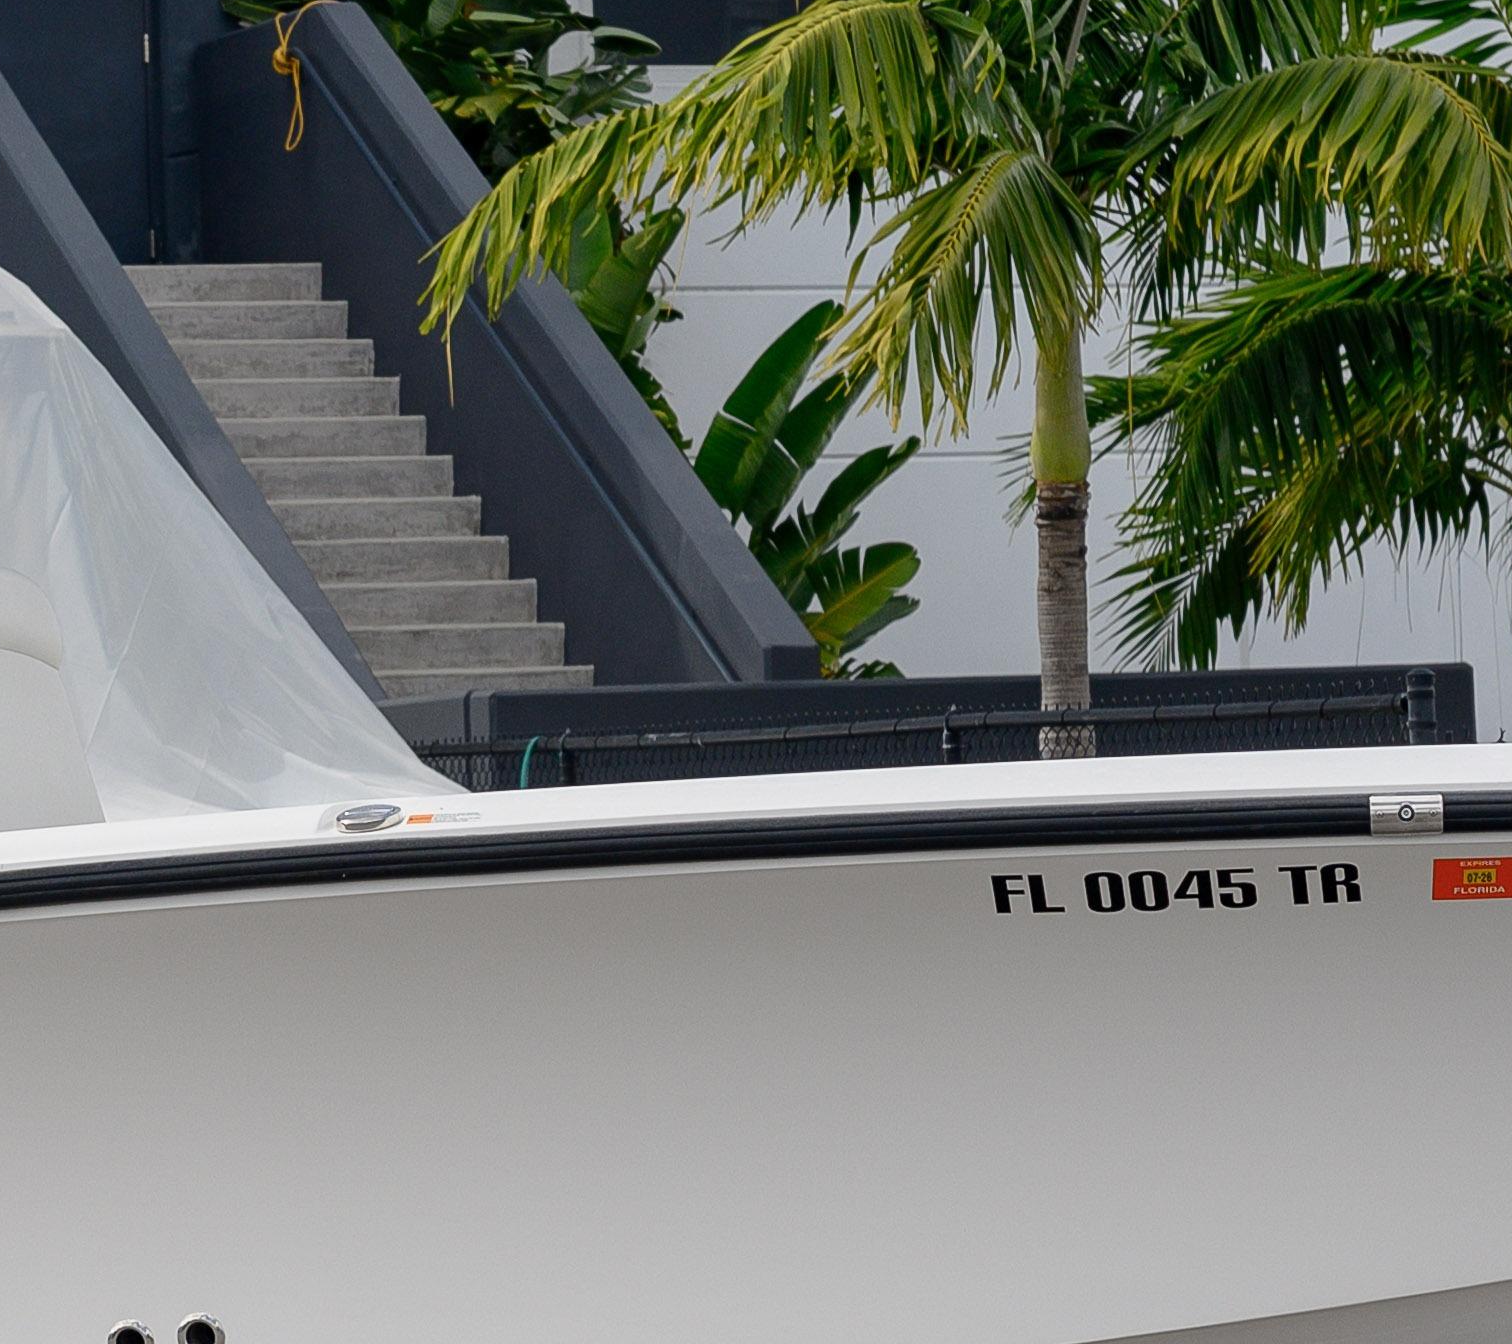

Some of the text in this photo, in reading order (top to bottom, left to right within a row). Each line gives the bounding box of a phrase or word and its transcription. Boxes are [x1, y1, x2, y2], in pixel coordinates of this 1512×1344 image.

[990, 862, 1363, 914] FL 0045 TR
[1453, 886, 1506, 894] FLORIDA
